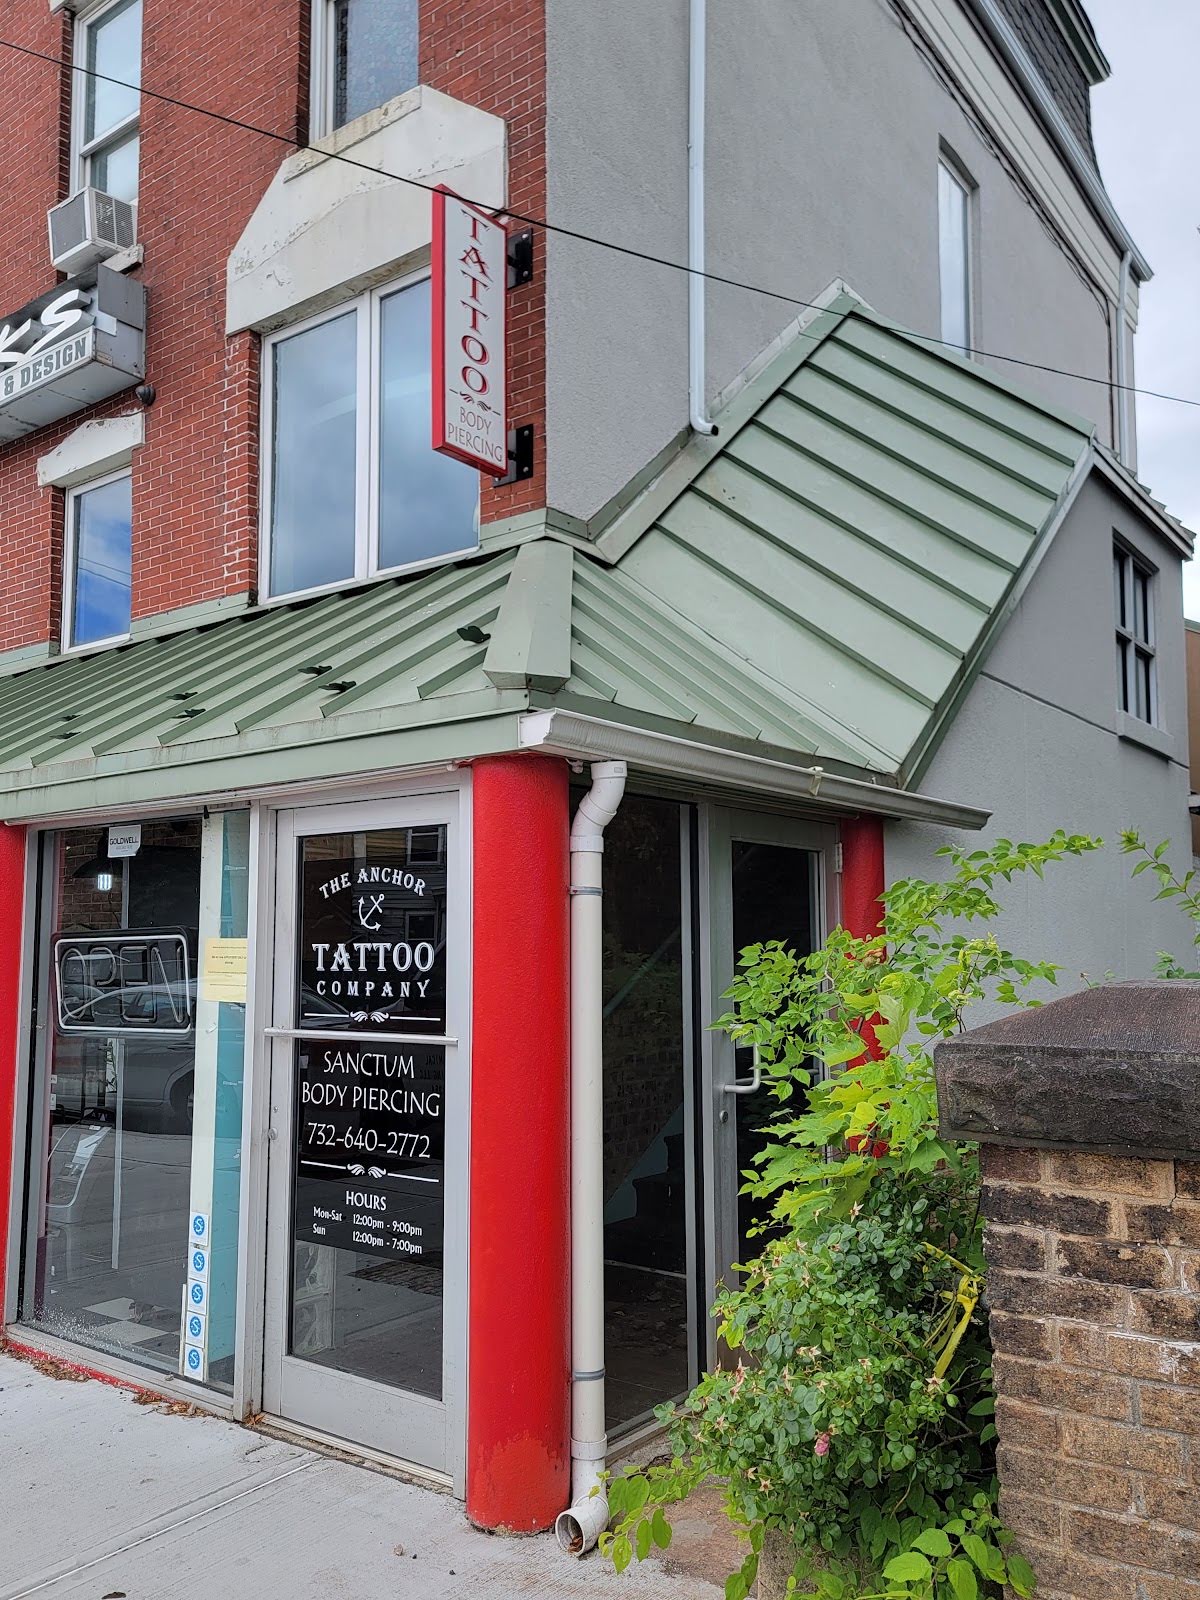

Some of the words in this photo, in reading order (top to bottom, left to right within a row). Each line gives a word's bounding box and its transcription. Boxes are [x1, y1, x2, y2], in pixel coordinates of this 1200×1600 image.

[459, 208, 492, 396] TATTOO
[4, 375, 14, 396] &
[19, 336, 87, 389] DESIGN
[459, 406, 492, 436] BODY
[447, 422, 503, 463] PIERCING
[109, 836, 139, 845] GOLDWELL
[318, 872, 352, 900] THE
[357, 866, 427, 897] ANCHOR
[311, 941, 436, 973] TATTOO
[60, 944, 186, 1025] OPEN
[316, 978, 431, 998] COMPANY
[323, 1050, 415, 1079] SANCTUM
[301, 1080, 348, 1107] BODY
[352, 1085, 440, 1117] PIERCING
[307, 1121, 431, 1159] 732-640-2772
[345, 1190, 387, 1211] HOURS
[313, 1206, 343, 1222] Mon-Sat
[353, 1213, 384, 1230] 12:00pm
[392, 1220, 423, 1237] 9:00pm
[312, 1223, 327, 1236] Sun
[352, 1230, 384, 1247] 12:00pm
[392, 1238, 423, 1255] 7:00pm
